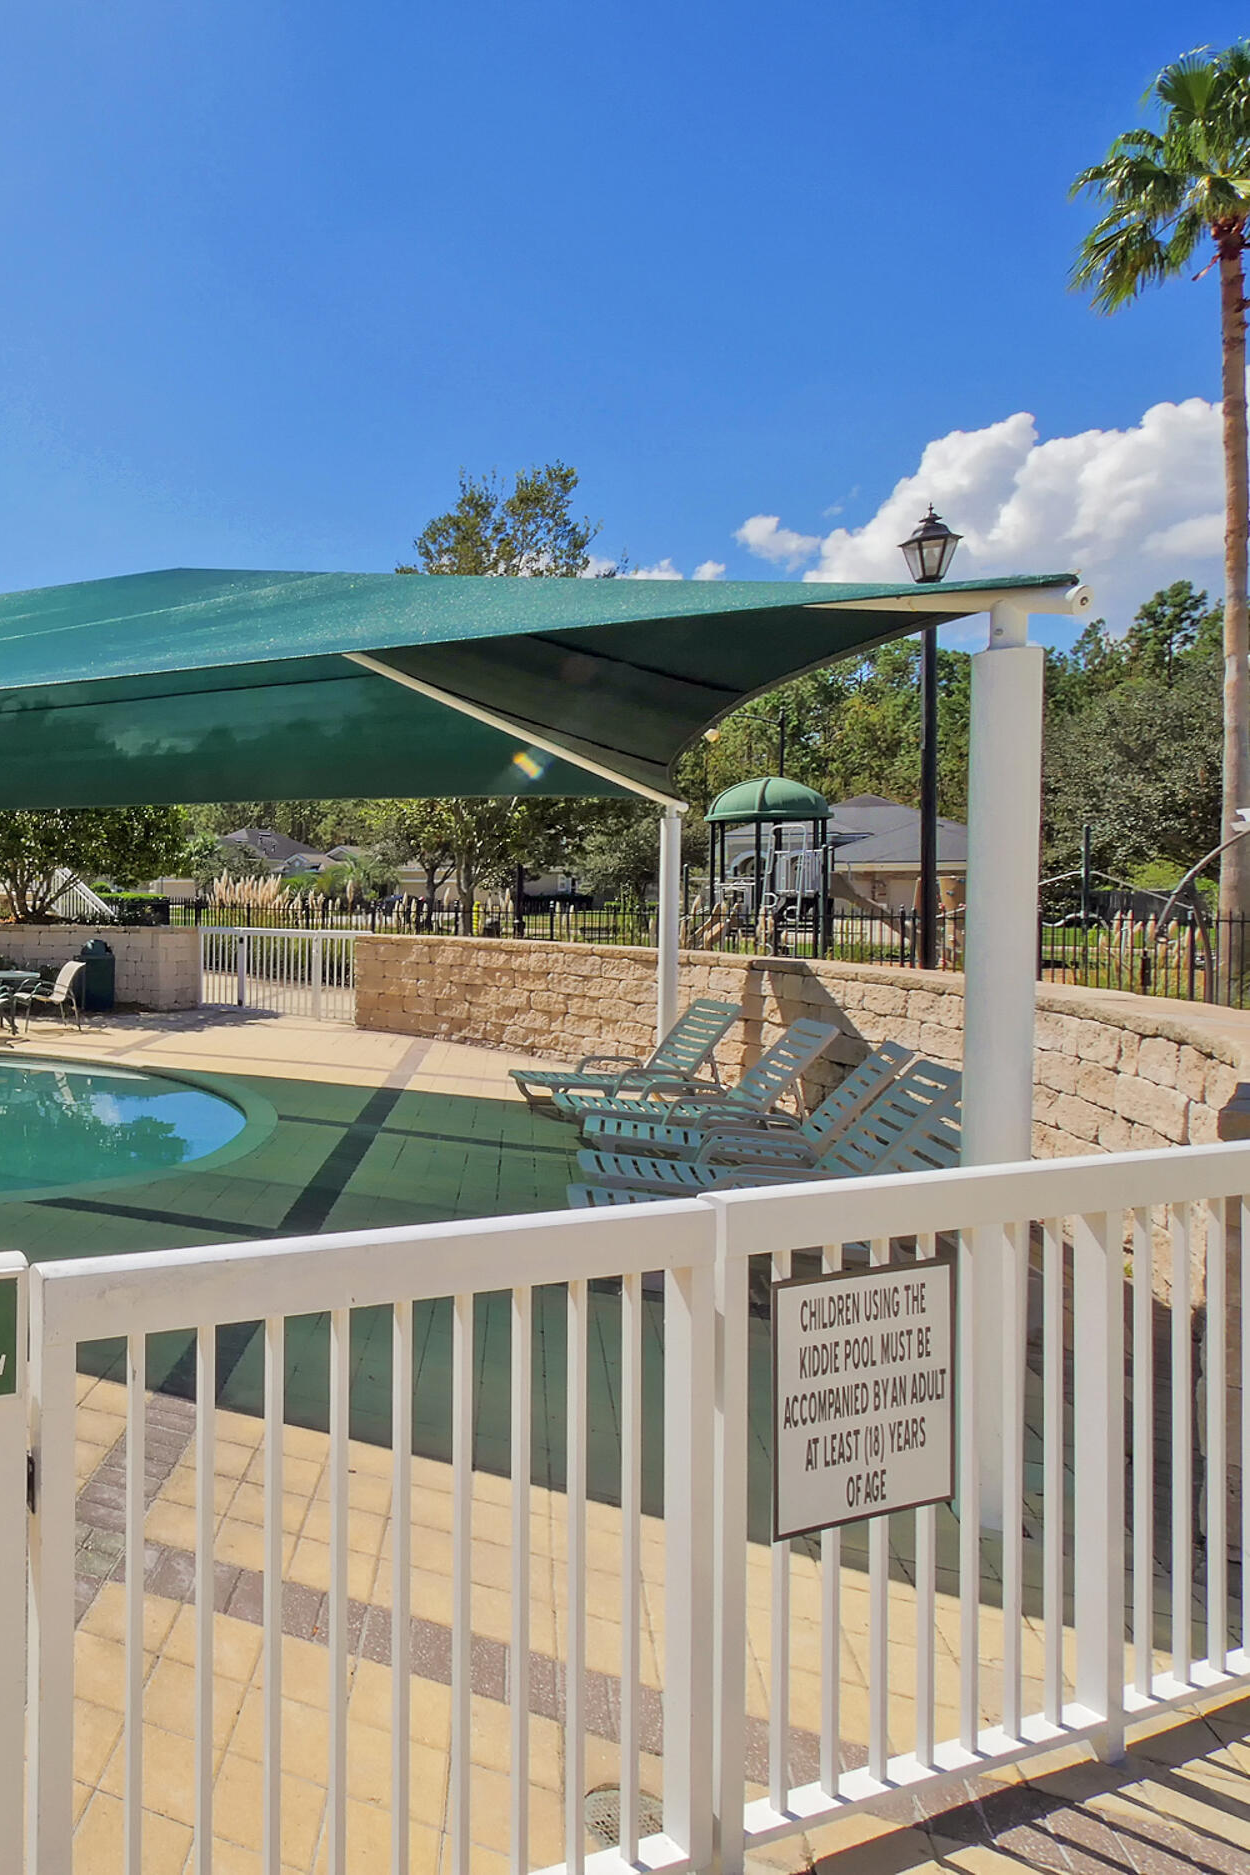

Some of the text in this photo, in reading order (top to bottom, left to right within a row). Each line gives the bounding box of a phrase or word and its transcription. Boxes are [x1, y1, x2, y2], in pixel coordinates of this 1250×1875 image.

[800, 1282, 926, 1333] CHILDREN USING THE
[799, 1326, 931, 1380] KIDDIE POOL MUST BE
[783, 1368, 946, 1430] ACCOMPANIED BY AN ADULT
[805, 1416, 926, 1472] AT LEAST (18) YEARS
[846, 1468, 887, 1508] OF AGE
